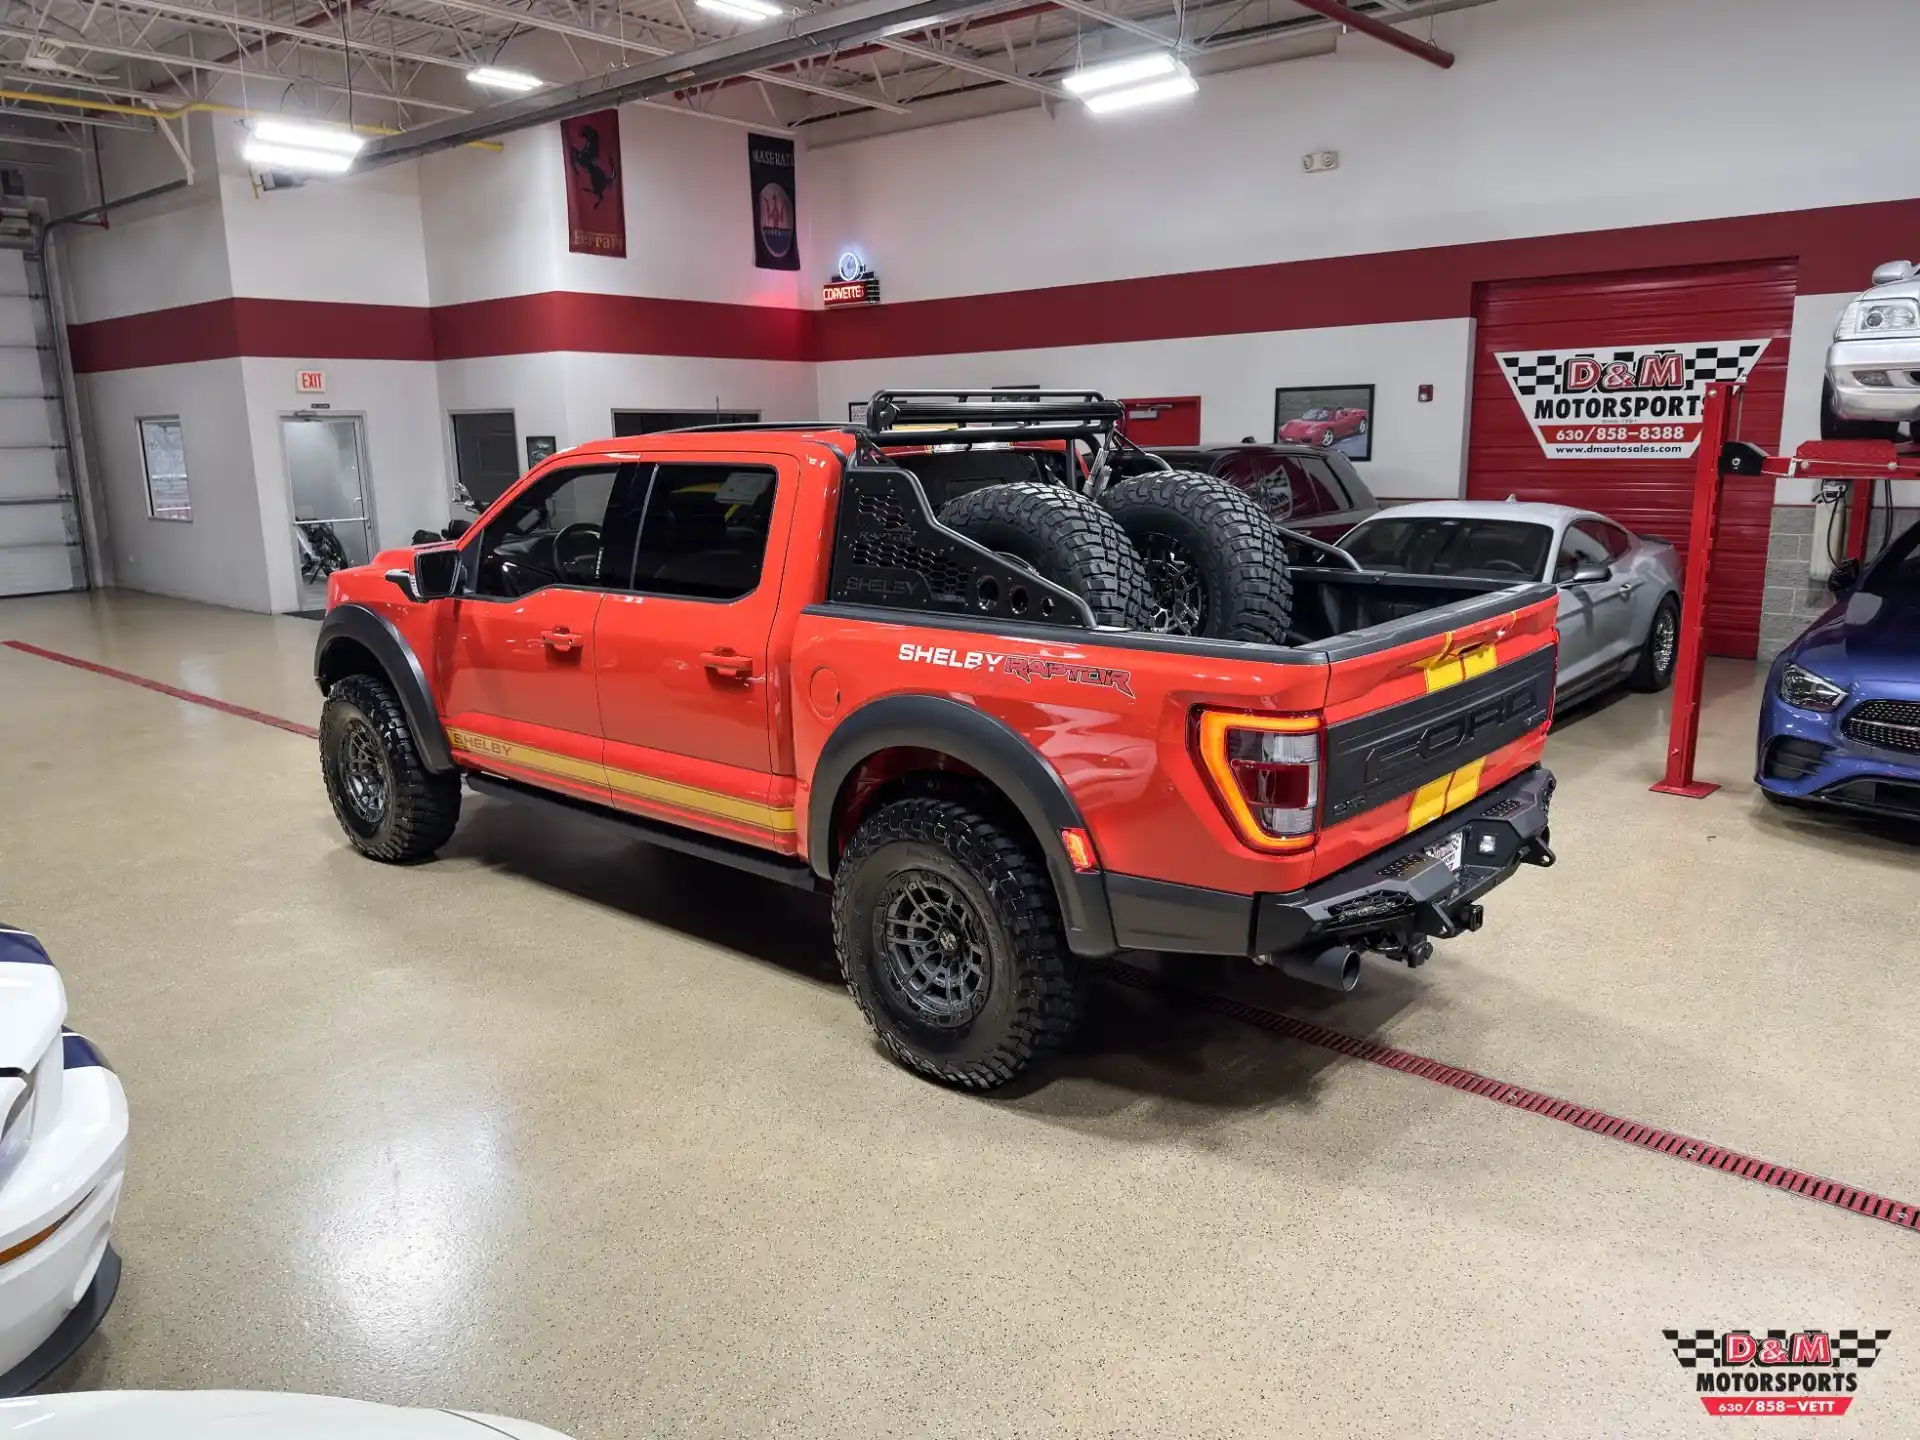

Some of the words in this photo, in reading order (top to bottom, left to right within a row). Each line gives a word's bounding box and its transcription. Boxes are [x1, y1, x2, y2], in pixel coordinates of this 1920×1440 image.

[573, 230, 624, 249] Ferrari
[823, 285, 862, 301] CORVETTE
[301, 371, 322, 389] EXIT
[1563, 352, 1685, 394] D&M
[1555, 444, 1682, 454] www.dmautosales.com
[898, 643, 1004, 672] SHELBY
[1002, 656, 1137, 700] RAPTOR
[1364, 679, 1538, 786] FORD
[453, 732, 513, 757] SHELBY
